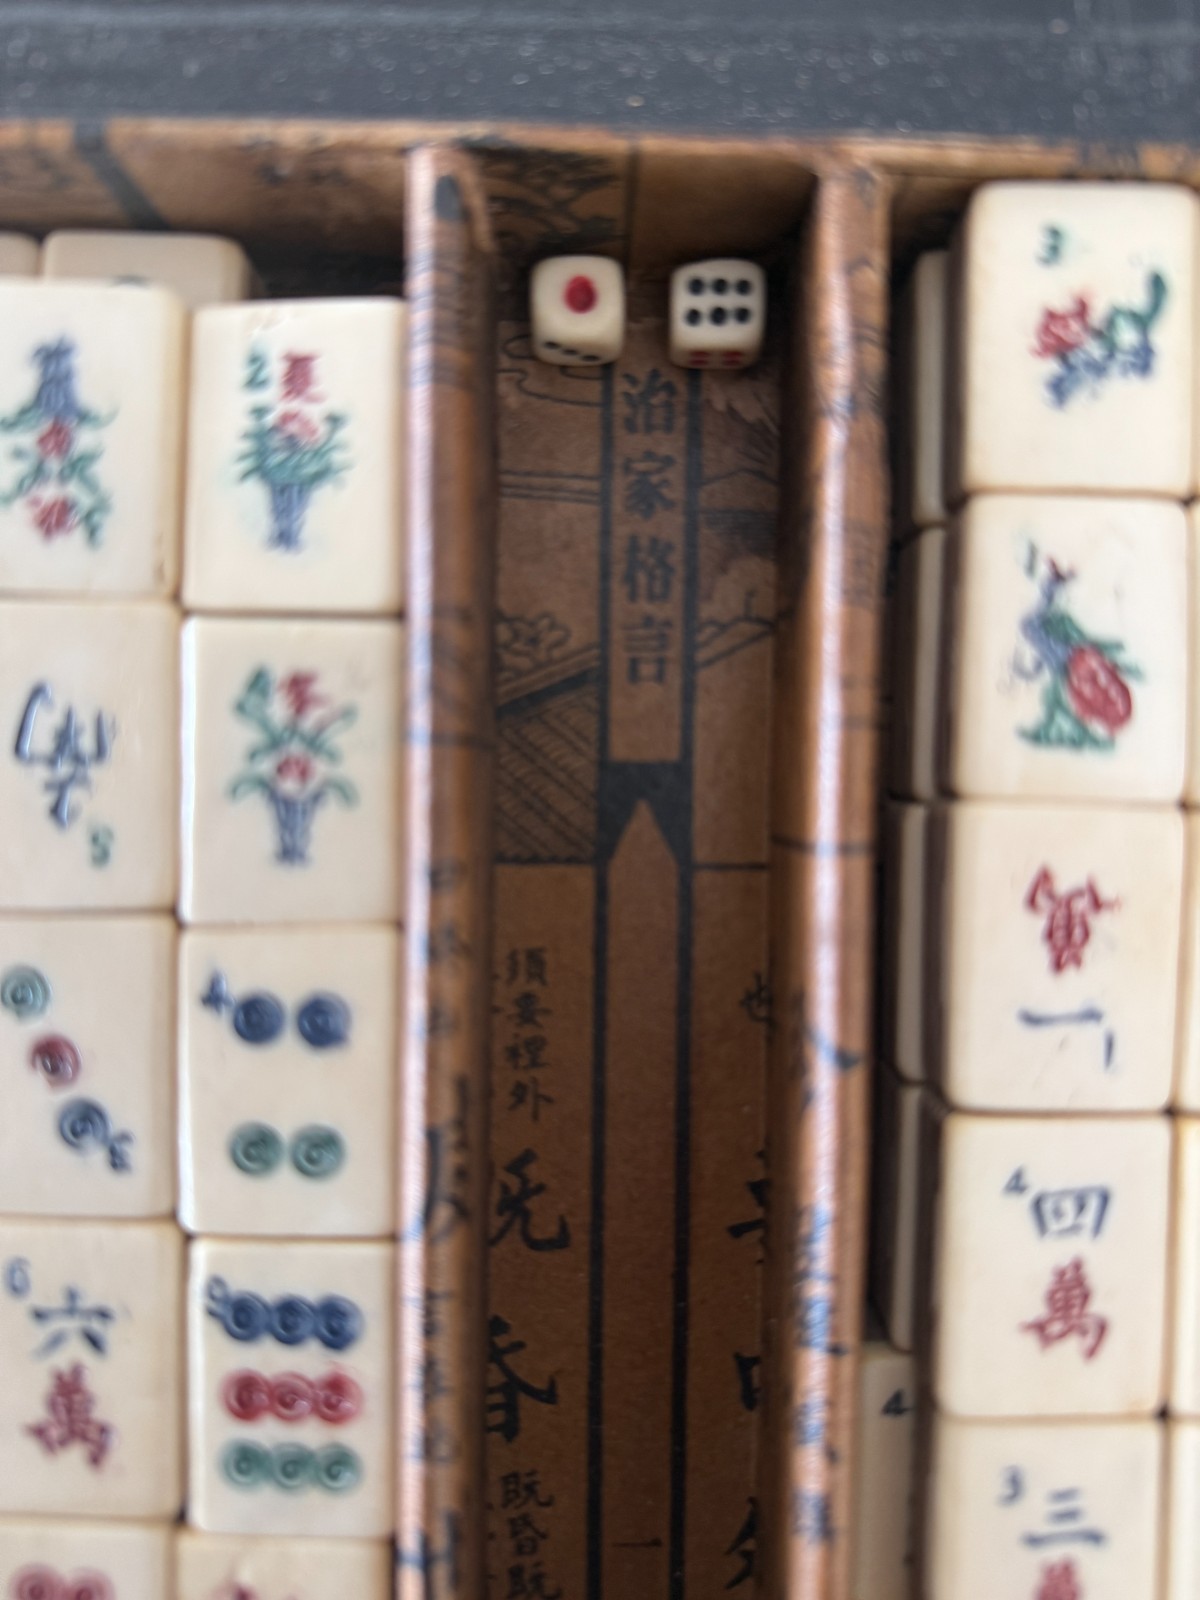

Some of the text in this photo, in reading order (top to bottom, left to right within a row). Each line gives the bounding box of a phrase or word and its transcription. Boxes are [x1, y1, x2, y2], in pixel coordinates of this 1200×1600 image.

[1036, 224, 1064, 266] 3
[244, 349, 270, 391] 2
[620, 368, 678, 684] 治家格言
[1002, 1166, 1030, 1195] 4
[4, 1257, 32, 1299] 6
